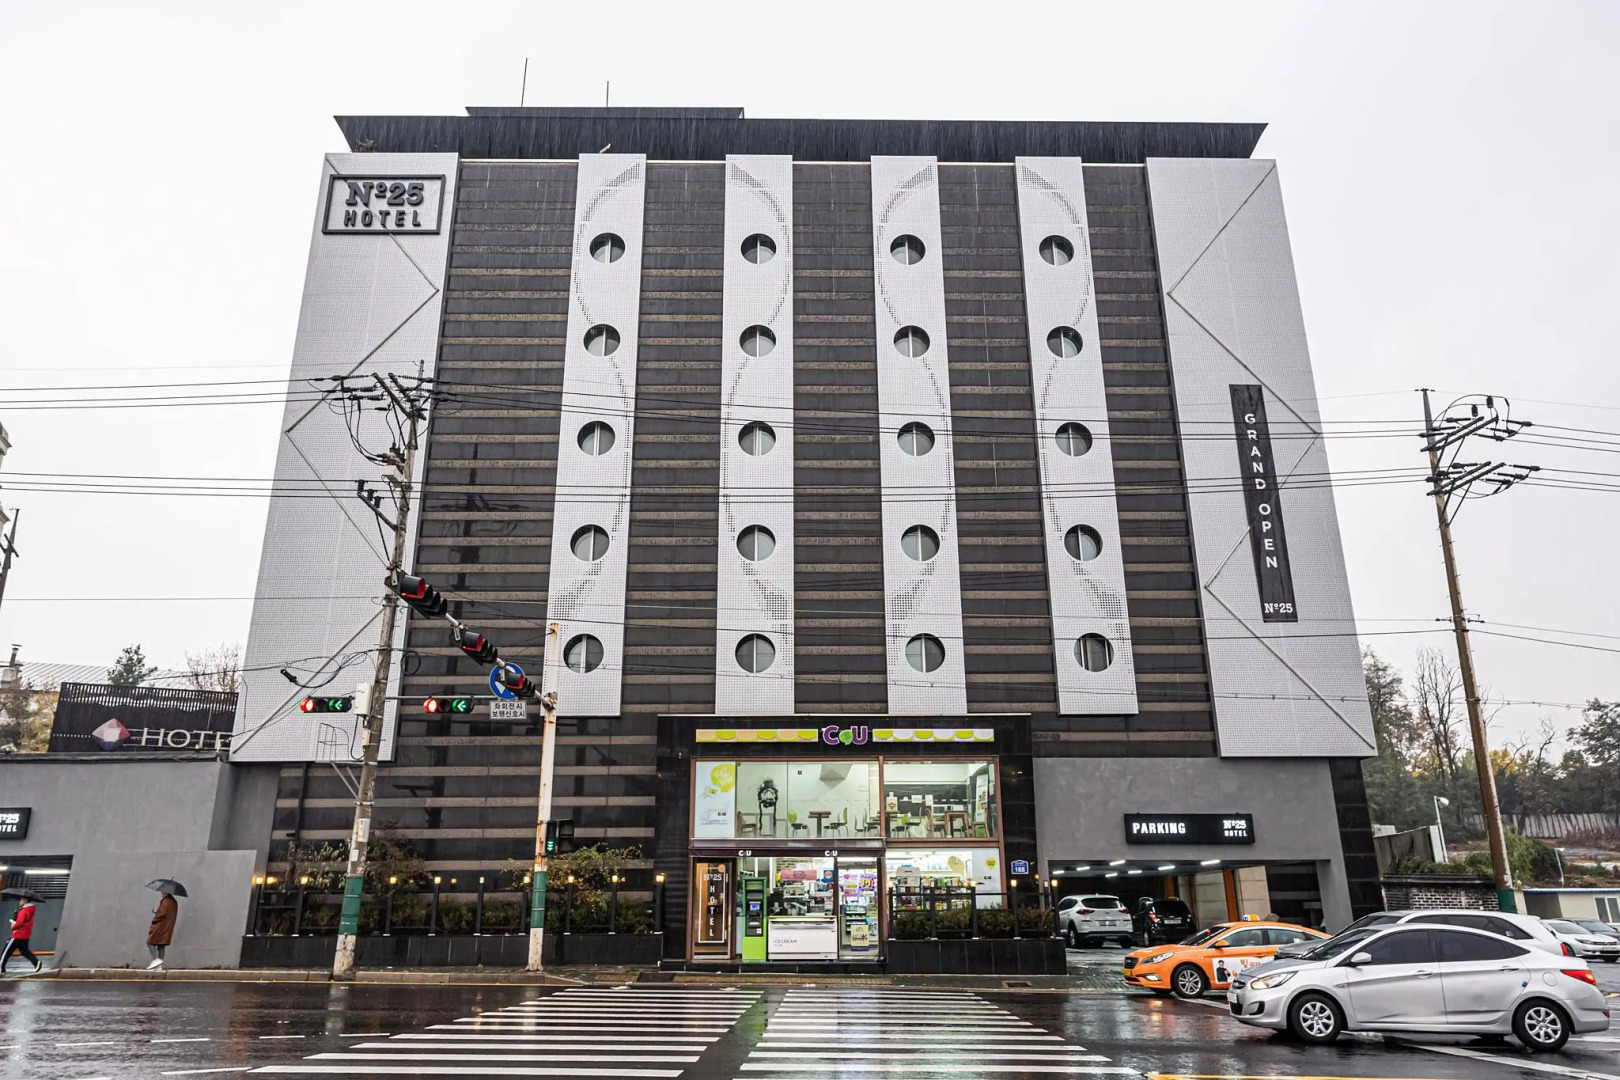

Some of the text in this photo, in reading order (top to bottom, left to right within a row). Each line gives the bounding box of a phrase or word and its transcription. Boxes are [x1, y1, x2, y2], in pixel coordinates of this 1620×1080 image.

[343, 209, 422, 228] HOTEL
[1244, 413, 1266, 490] GRAND
[1258, 503, 1278, 568] OPEN
[1132, 822, 1186, 834] PARKING
